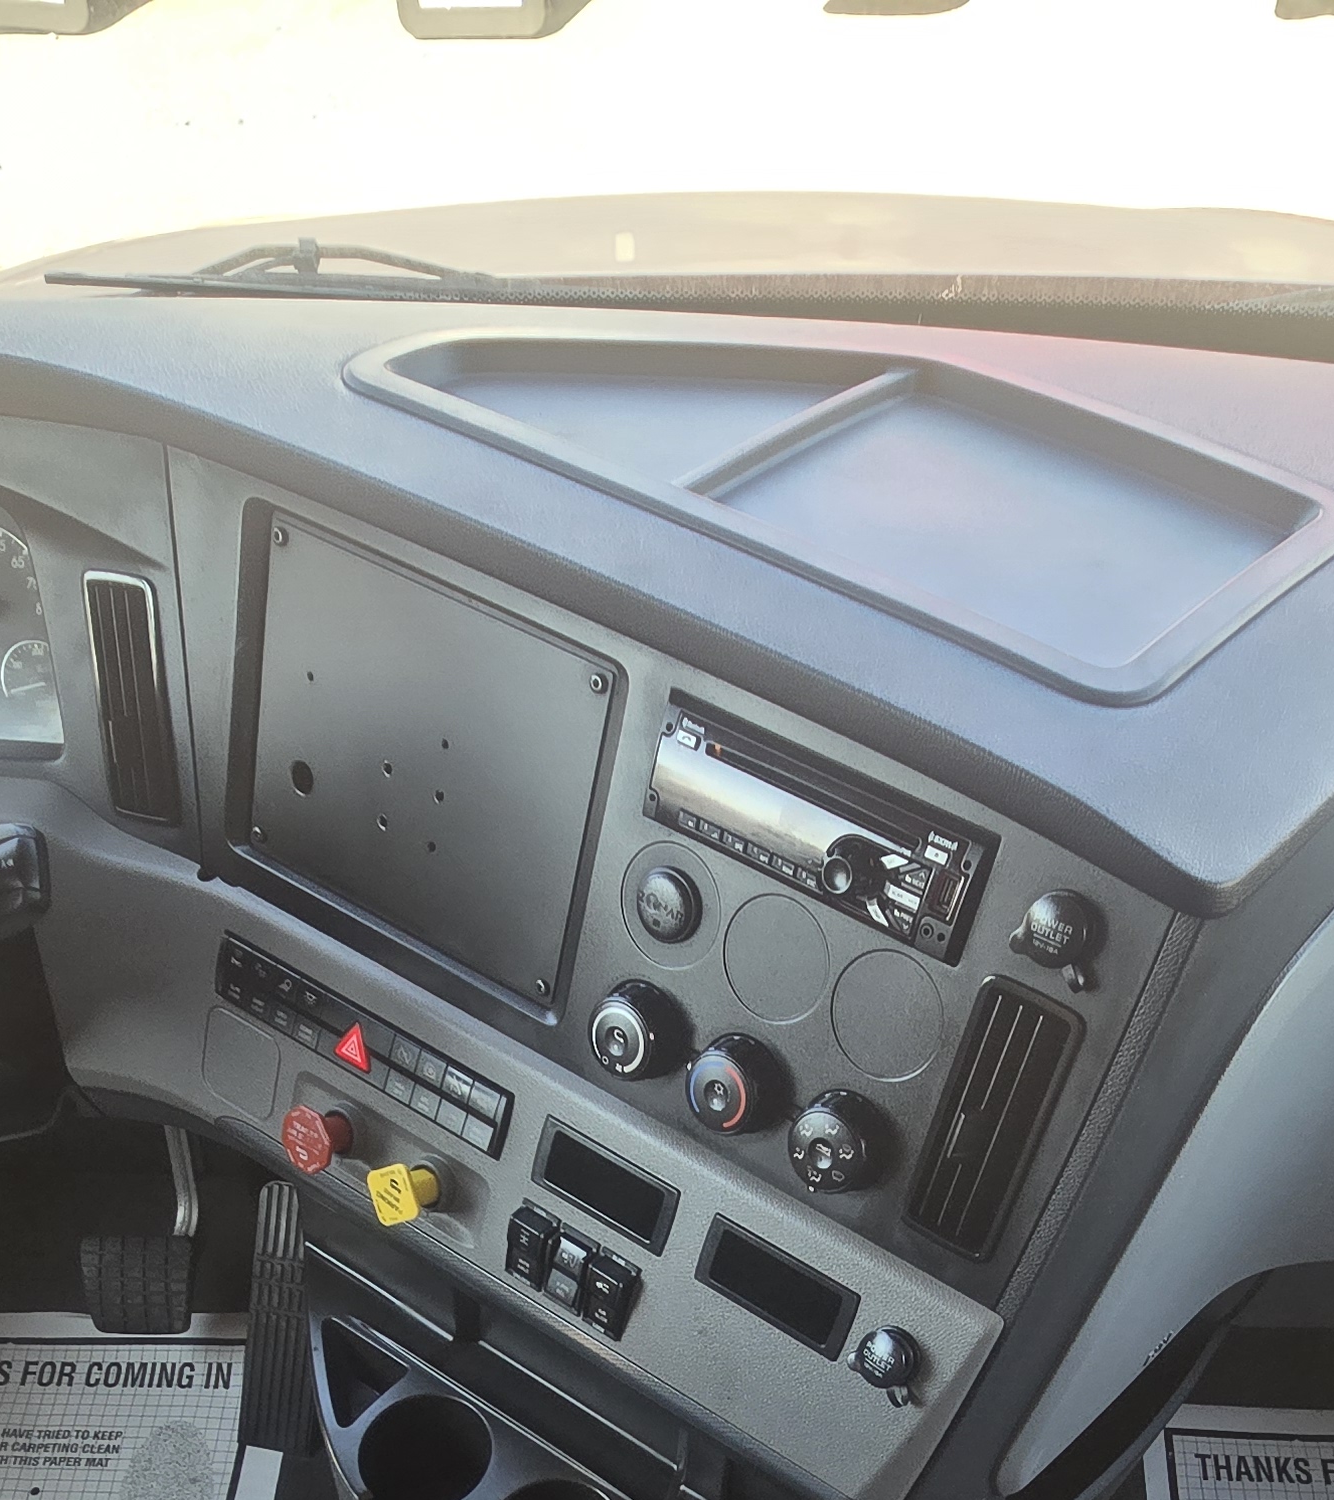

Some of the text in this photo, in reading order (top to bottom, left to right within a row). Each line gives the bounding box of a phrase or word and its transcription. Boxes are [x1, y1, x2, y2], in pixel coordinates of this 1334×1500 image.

[11, 556, 25, 568] 65
[1030, 922, 1070, 945] OUTLET
[862, 1348, 892, 1372] OUTLET
[19, 1360, 77, 1387] FOR
[85, 1361, 195, 1389] COMING
[203, 1362, 233, 1389] IN
[1, 1428, 34, 1439] HAVE
[36, 1429, 71, 1440] TRIED
[74, 1429, 90, 1440] TO
[92, 1430, 123, 1441] KEEP
[11, 1441, 78, 1453] CARPETING
[82, 1444, 120, 1454] CLEAN
[11, 1455, 40, 1466] THIS
[42, 1456, 81, 1467] PAPER
[85, 1457, 111, 1468] MAT
[1194, 1453, 1313, 1485] THANKS
